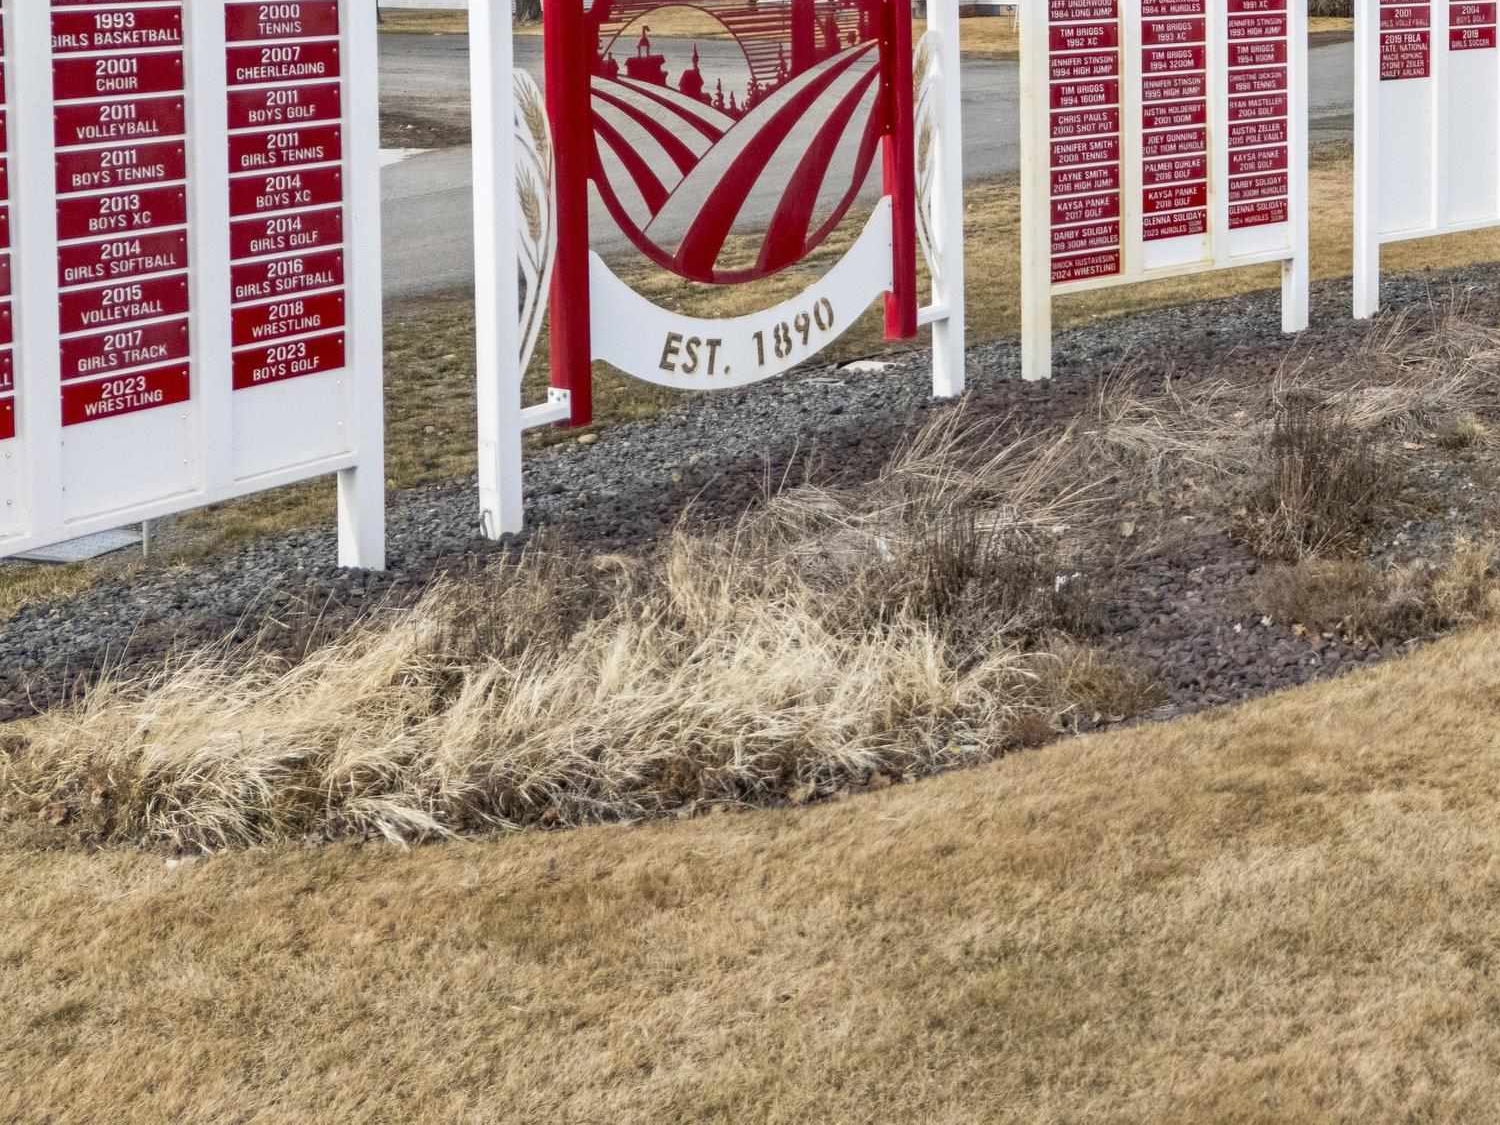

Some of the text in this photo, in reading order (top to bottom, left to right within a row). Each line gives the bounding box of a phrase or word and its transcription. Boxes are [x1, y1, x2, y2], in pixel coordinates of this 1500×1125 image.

[259, 3, 299, 19] 2000
[1051, 0, 1064, 8] JEFF
[1071, 8, 1090, 17] LONG
[1093, 7, 1112, 15] JUMP
[95, 11, 134, 29] 1993
[259, 21, 301, 34] TENNIS
[1152, 22, 1192, 31] TIM BRIGGS
[94, 27, 179, 45] BASKETBALL
[1060, 26, 1103, 36] TIM BRIGGS
[1177, 31, 1185, 40] XC
[1067, 37, 1097, 47] 1992 XC
[1237, 45, 1248, 53] TIM
[261, 46, 300, 63] 2007
[1050, 57, 1081, 66] JENNIFER
[1152, 49, 1191, 59] TIM BRIGGS
[95, 57, 136, 76] 2001
[236, 62, 324, 79] CHEERLEADING
[1073, 66, 1090, 75] HIGH
[1093, 64, 1111, 73] JUMP
[96, 75, 137, 91] CHOIR
[1061, 83, 1104, 94] TIM BRIGGS
[266, 89, 297, 106] 2011
[1080, 93, 1104, 103] 1600M
[100, 102, 135, 121] 2011
[249, 104, 314, 122] BOYS GOLF
[1058, 112, 1107, 124] CHRIS PAULS
[76, 119, 158, 140] VOLLEYBALL
[1053, 121, 1111, 134] 2000 SHOT PUT
[267, 131, 298, 149] 2011
[1054, 140, 1112, 153] JENNIFER SMITH
[100, 148, 136, 167] 2011
[241, 146, 323, 166] GIRLS TENNIS
[72, 163, 164, 186] BOYS TENNIS
[265, 174, 301, 192] 2014
[1058, 169, 1107, 182] LAYNE SMITH
[99, 193, 139, 214] 2013
[256, 189, 310, 207] BOYS XC
[1057, 200, 1082, 211] KAYSA
[89, 210, 150, 231] BOYS XC
[1065, 207, 1101, 220] 2017 GOLF
[266, 216, 301, 235] 2014
[100, 238, 140, 259] 2014
[250, 230, 317, 252] GIRLS GOLF
[64, 252, 175, 281] GIRLS SOFTBALL
[267, 258, 302, 277] 2016
[235, 270, 333, 298] GIRLS SOFTBALL
[102, 284, 141, 305] 2015
[81, 299, 162, 324] VOLLEYBALL
[268, 300, 303, 320] 2018
[252, 314, 320, 337] WRESTLING
[103, 329, 142, 351] 2017
[659, 297, 834, 375] EST. 1890
[78, 343, 166, 372] GIRLS TRACK
[266, 342, 305, 363] 2023
[253, 356, 318, 380] BOYS GOLF
[101, 375, 145, 399] 2023
[85, 388, 162, 416] WRESTLING
